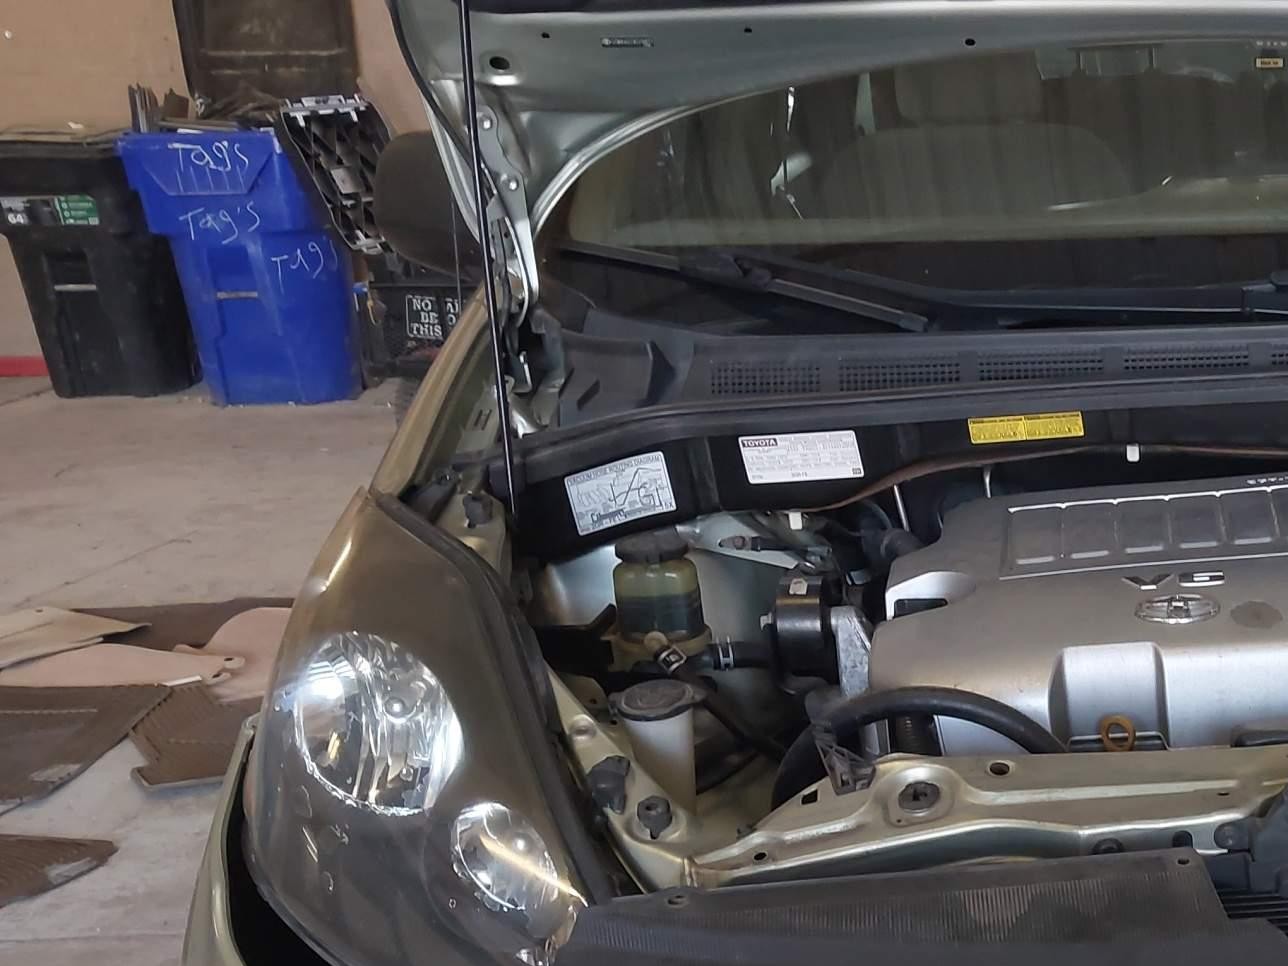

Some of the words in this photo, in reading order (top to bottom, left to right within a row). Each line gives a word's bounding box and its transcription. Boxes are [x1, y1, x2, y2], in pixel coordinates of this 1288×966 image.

[411, 298, 432, 311] NO
[410, 323, 443, 337] THIS
[741, 438, 778, 448] TOYOTA
